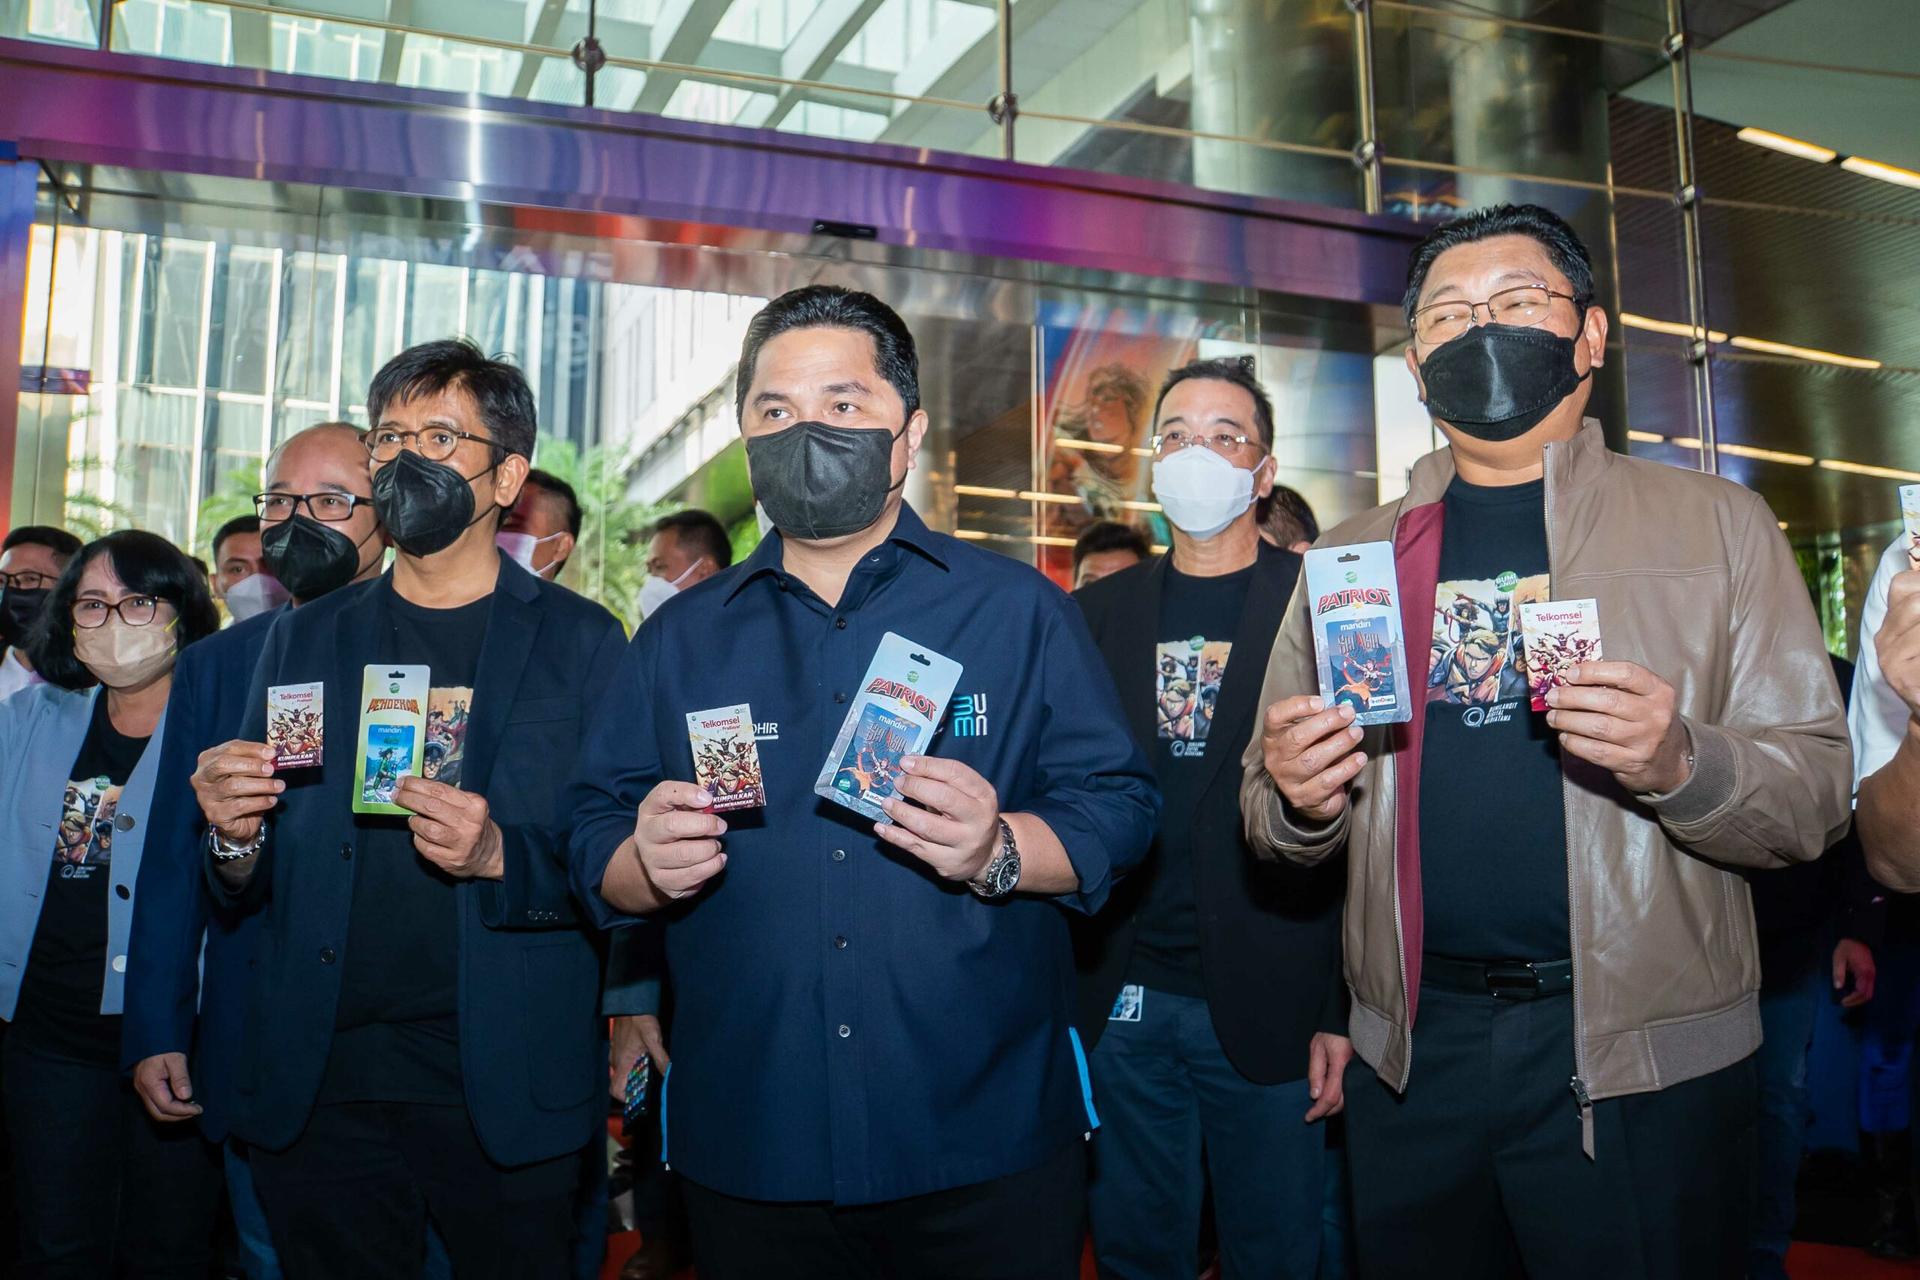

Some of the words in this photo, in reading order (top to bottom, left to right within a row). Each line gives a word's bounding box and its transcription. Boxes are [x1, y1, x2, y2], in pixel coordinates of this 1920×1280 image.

[1316, 587, 1392, 616] PATRIOT
[1536, 610, 1583, 622] Telkomsel
[1340, 620, 1371, 631] mandiri
[280, 691, 313, 700] Telkomsel
[864, 677, 938, 721] PATRIOT
[701, 716, 740, 729] Telkomsel
[879, 715, 908, 732] mandiri
[713, 792, 753, 804] KUMPULKAN
